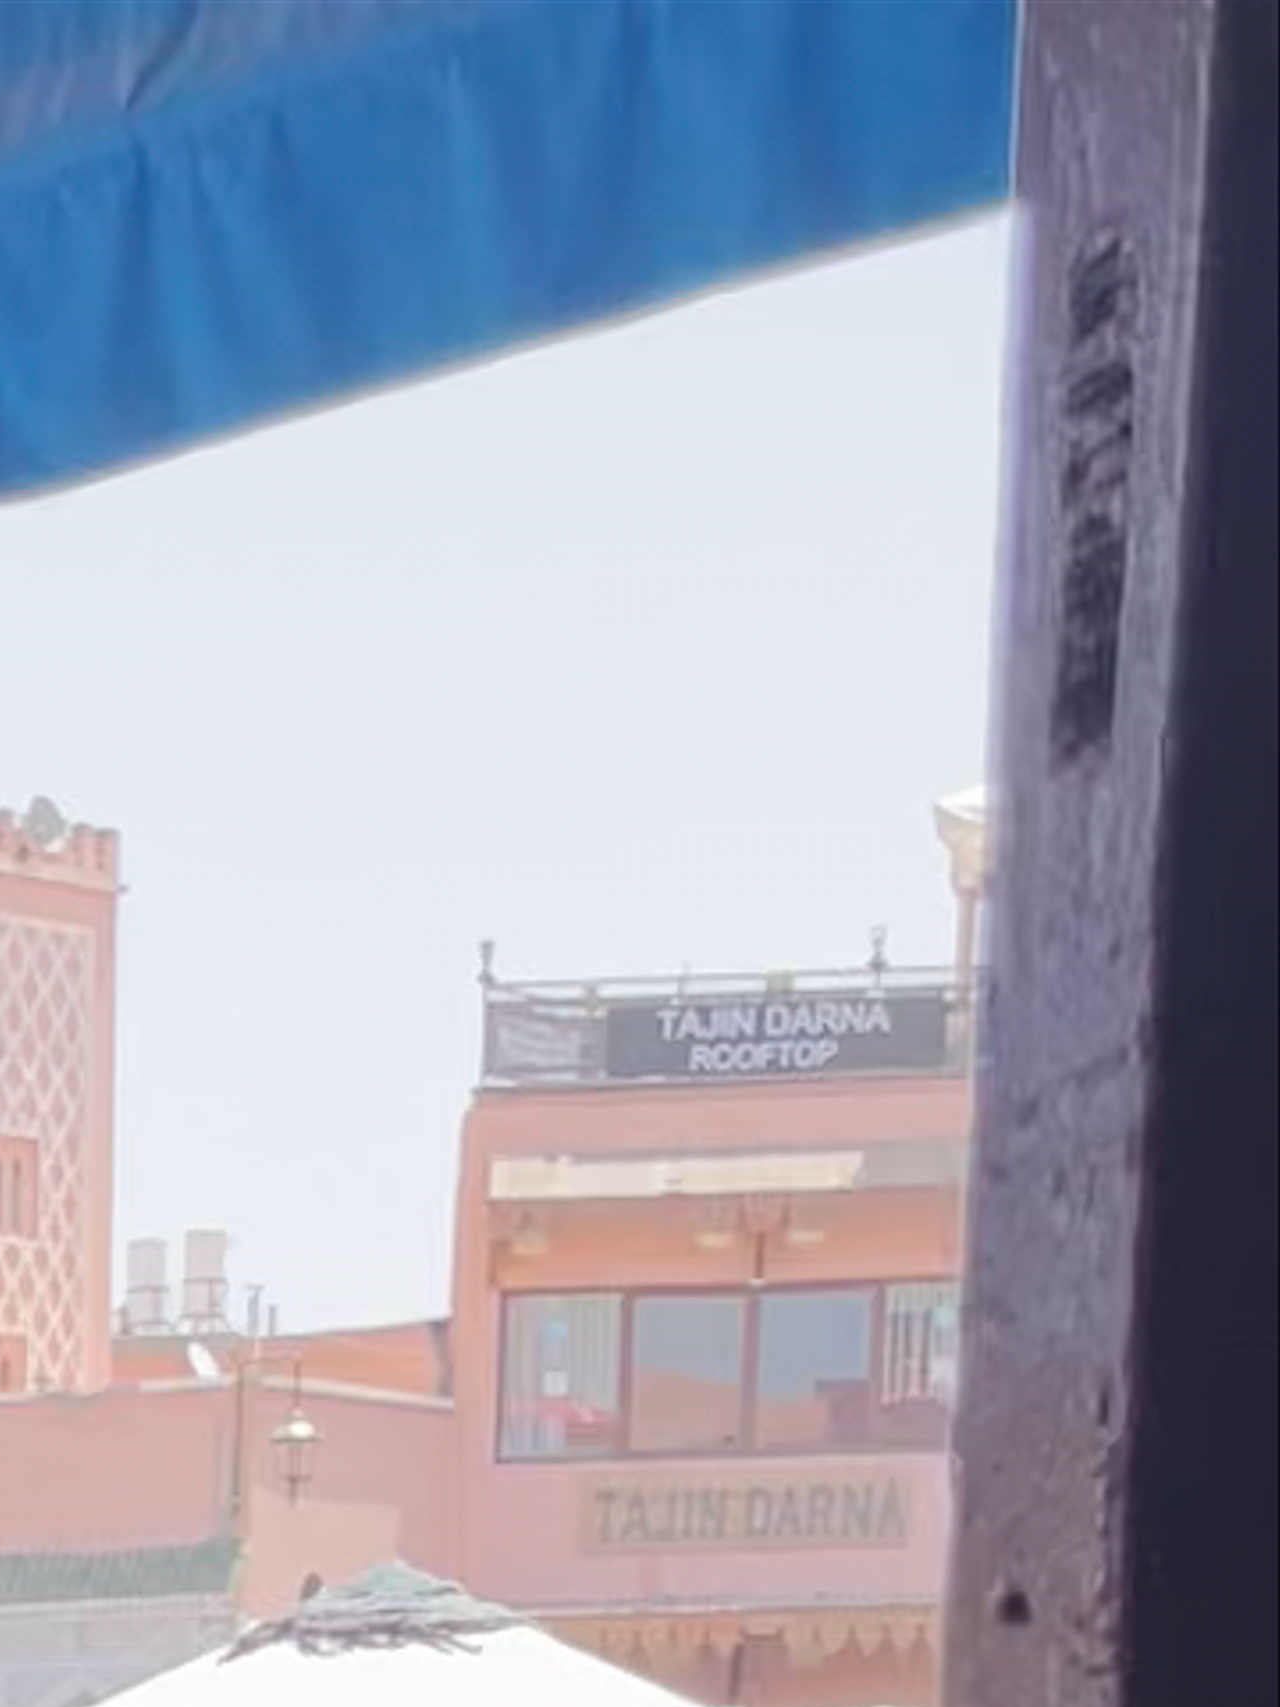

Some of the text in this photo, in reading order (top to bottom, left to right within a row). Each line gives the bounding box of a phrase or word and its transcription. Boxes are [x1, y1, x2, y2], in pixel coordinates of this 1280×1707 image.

[656, 1001, 892, 1041] TAJIN DARNA
[689, 1040, 840, 1071] ROOFTOP
[595, 1478, 907, 1544] TAJIN DARNA
